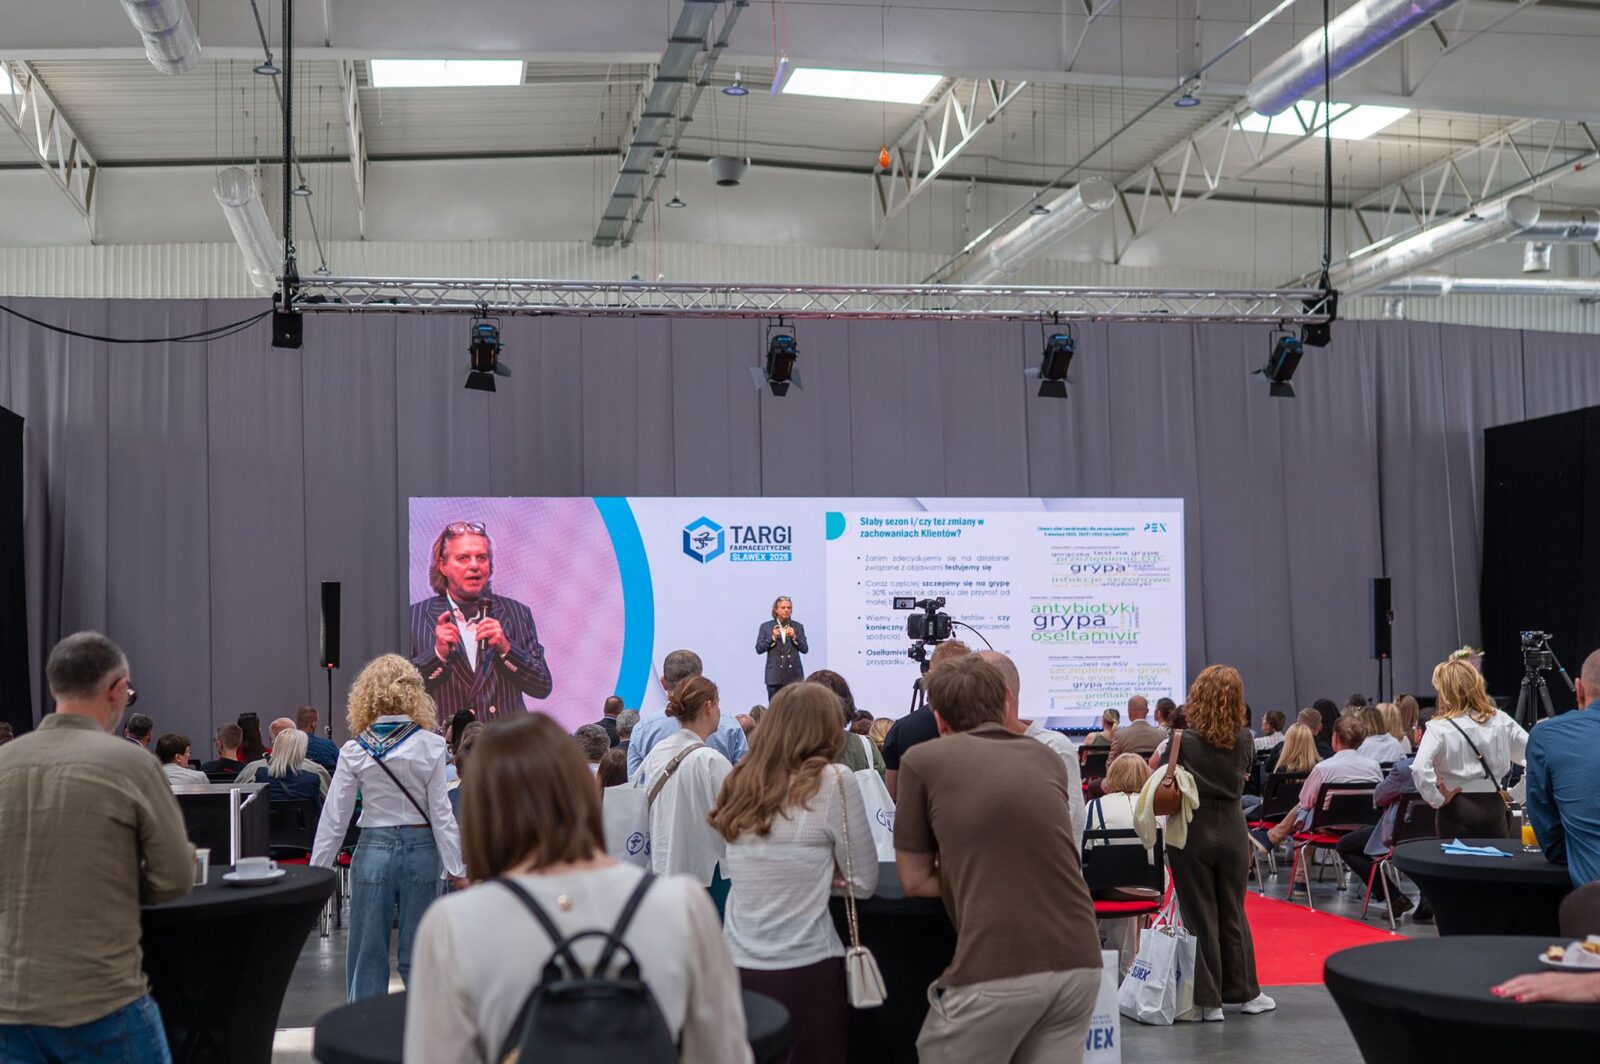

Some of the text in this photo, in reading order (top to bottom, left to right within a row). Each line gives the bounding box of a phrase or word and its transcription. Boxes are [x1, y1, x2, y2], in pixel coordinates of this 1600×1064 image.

[860, 517, 883, 528] Słaby
[885, 518, 908, 526] sezon
[934, 517, 945, 526] też
[948, 517, 976, 528] zmiany
[730, 526, 792, 544] TARGI
[860, 529, 961, 538] zachowaniach Klientów?
[1070, 563, 1126, 574] grypa
[1030, 602, 1136, 615] antybiotyki
[1034, 614, 1106, 630] grypa
[1031, 630, 1139, 641] oseltamivir
